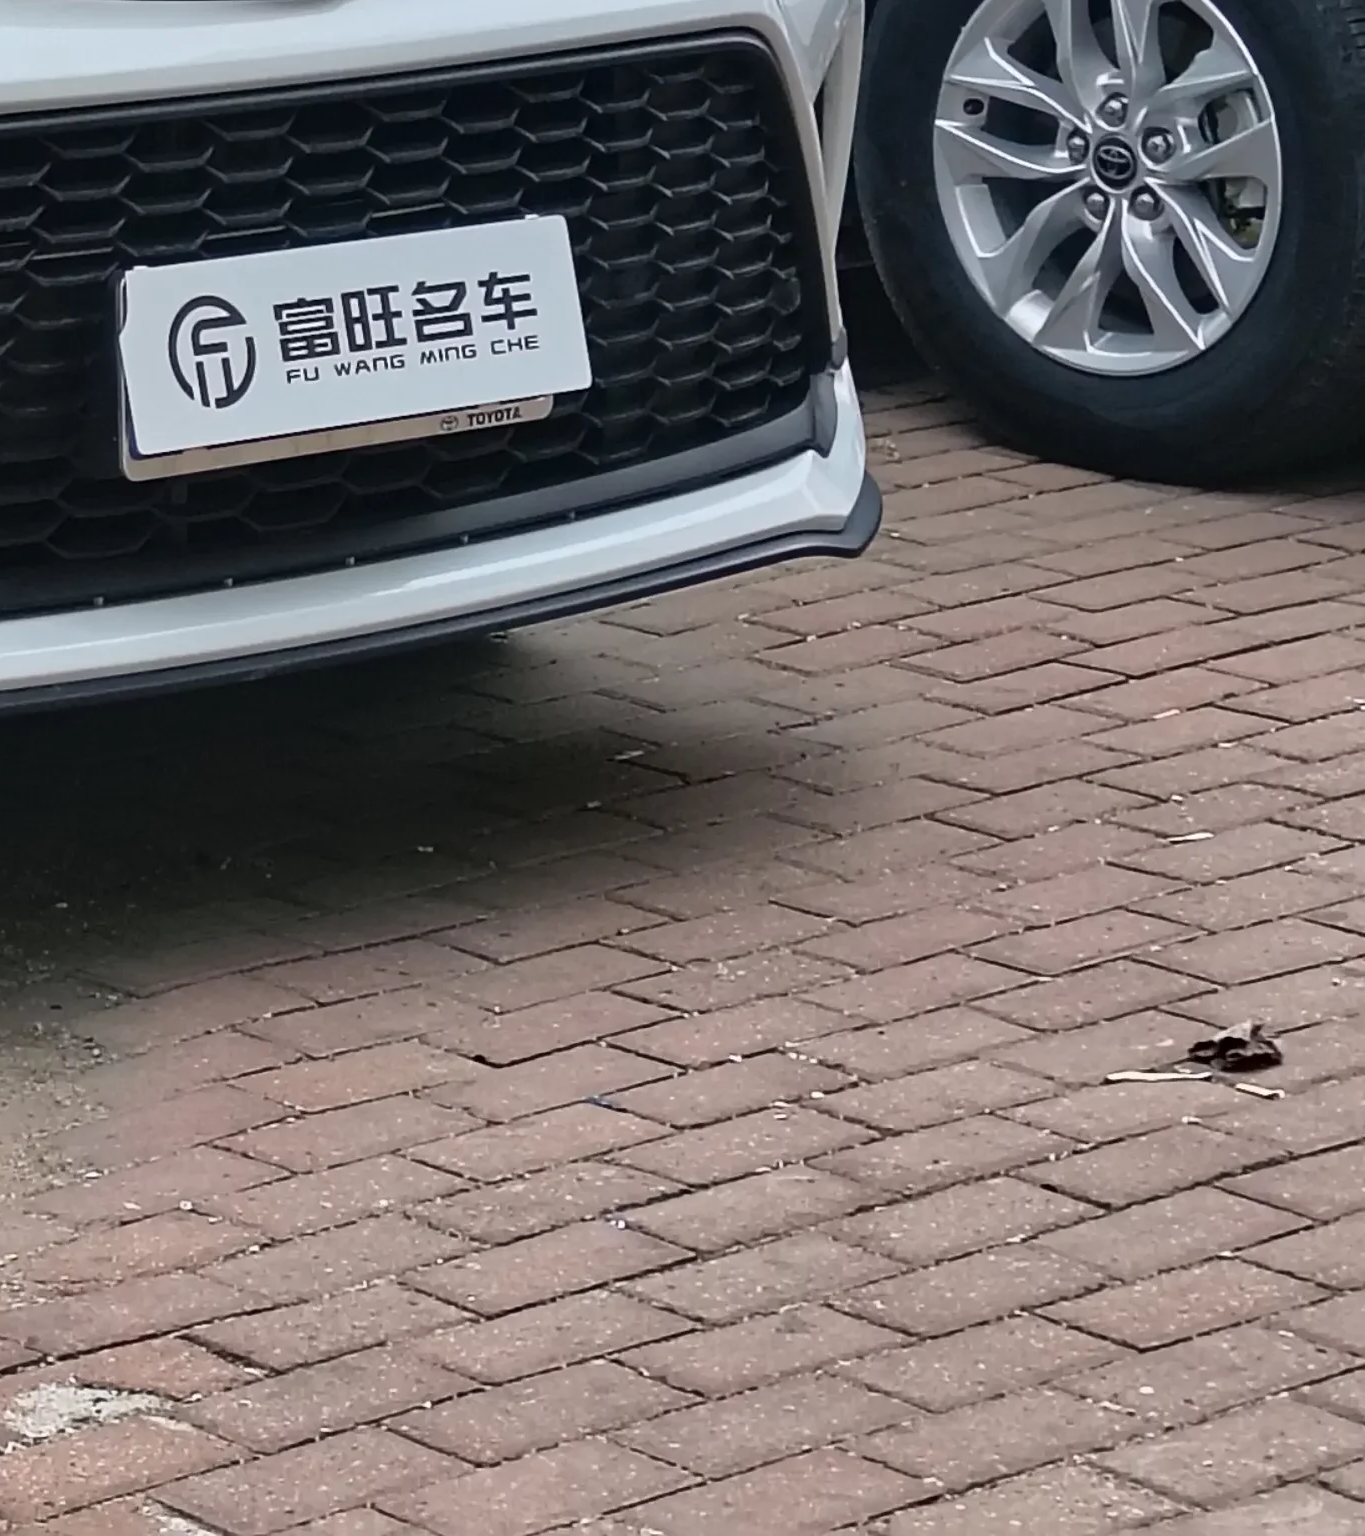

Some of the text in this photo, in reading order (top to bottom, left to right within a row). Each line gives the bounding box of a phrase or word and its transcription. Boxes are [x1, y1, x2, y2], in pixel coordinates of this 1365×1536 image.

[272, 271, 538, 362] 富旺名车
[285, 334, 540, 384] FU WANG MING CHE
[467, 406, 523, 427] TOYOTA
